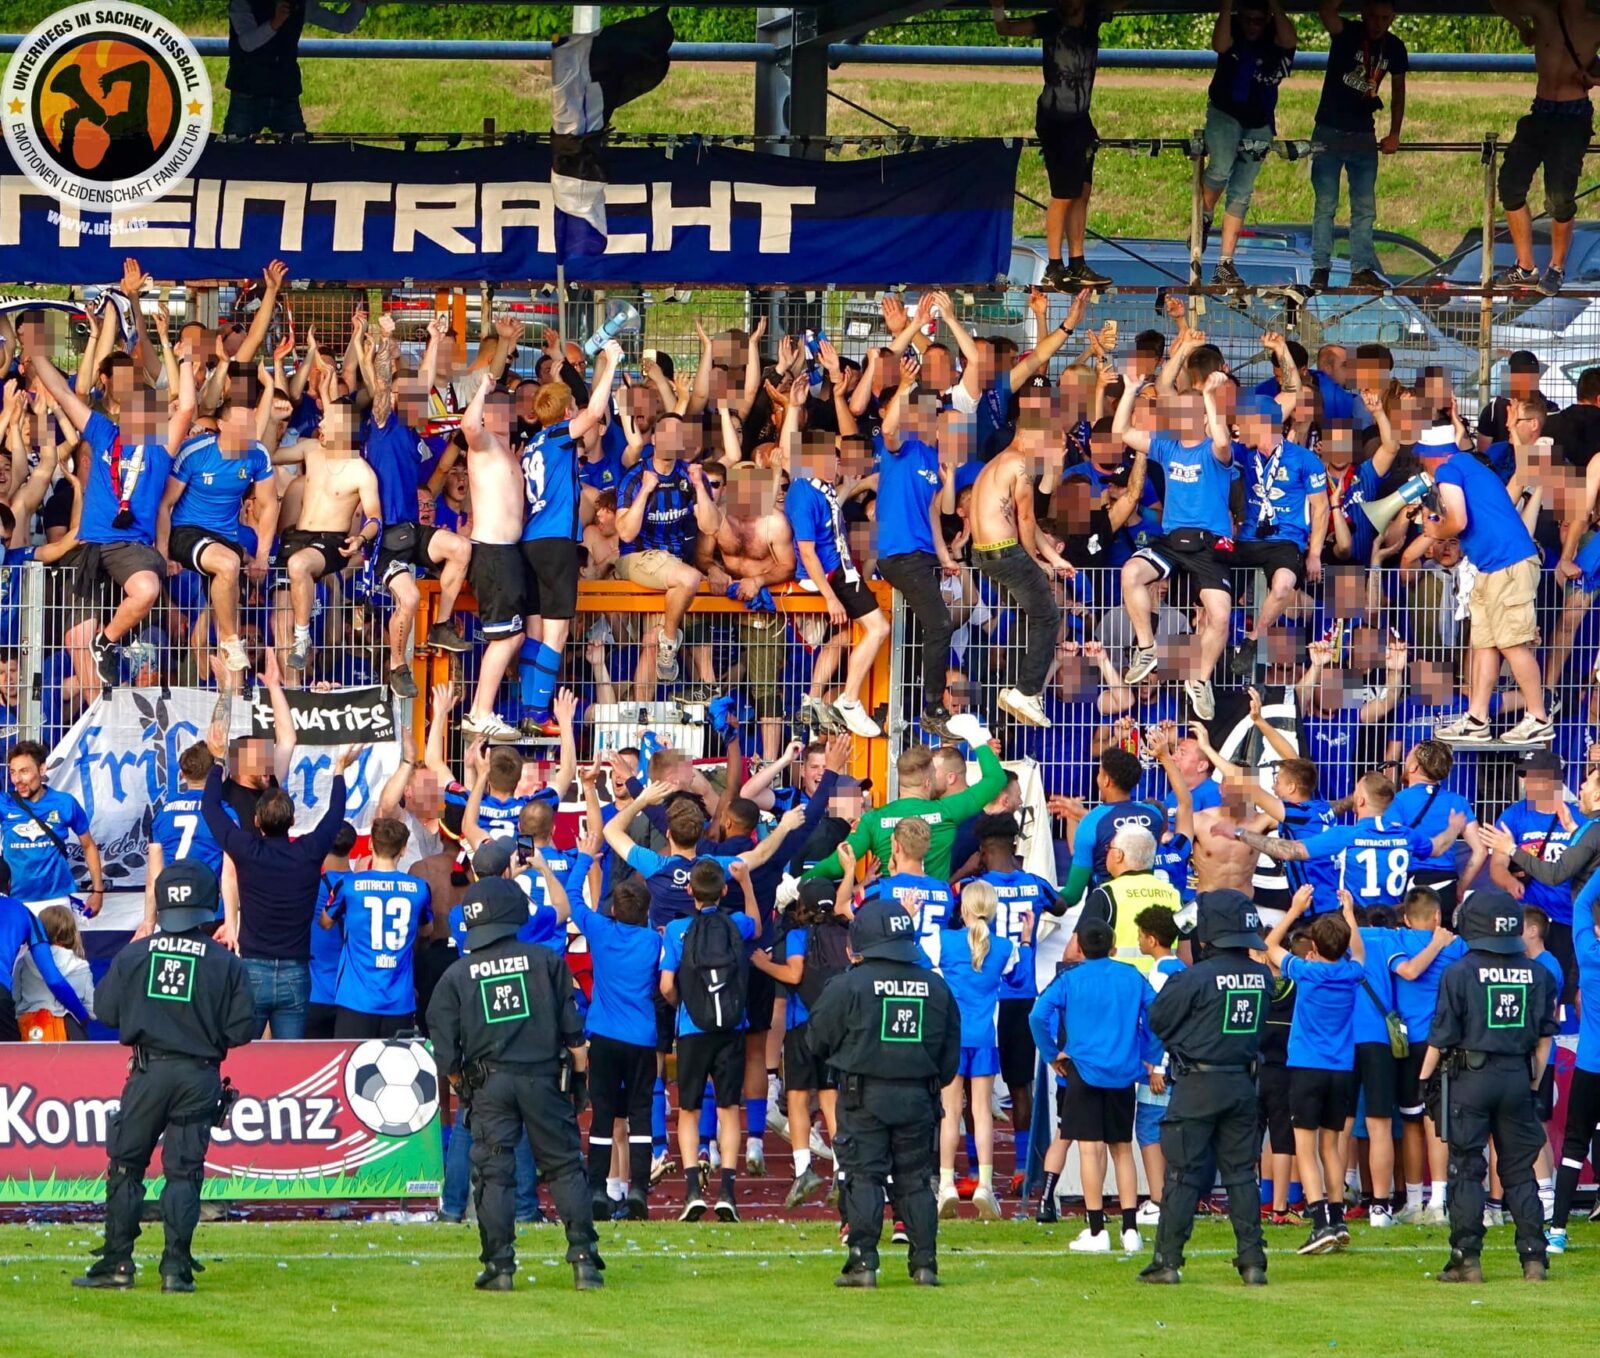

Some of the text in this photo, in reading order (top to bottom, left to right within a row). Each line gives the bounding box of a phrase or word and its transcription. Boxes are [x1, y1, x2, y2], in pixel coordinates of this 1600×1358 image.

[254, 704, 391, 731] FNATiCS
[173, 815, 198, 860] 7
[1354, 838, 1391, 847] EINTRACHT
[1355, 848, 1409, 897] 18
[354, 879, 418, 893] EINTRACHT TRIER
[893, 886, 929, 901] EINTCHT
[1126, 888, 1174, 899] SECURITY
[167, 885, 192, 903] RP
[463, 902, 484, 921] RP
[363, 896, 412, 951] 13
[889, 915, 911, 932] RP
[1245, 912, 1259, 928] RP
[1495, 917, 1518, 932] RP
[149, 937, 206, 957] POLIZEI
[164, 959, 182, 973] RP
[375, 953, 397, 968] KÖNIG
[469, 955, 529, 979] POLIZEI
[157, 971, 186, 986] 412
[1216, 974, 1266, 990] POLIZEI
[1479, 967, 1534, 983] POLIZEI
[495, 985, 512, 999] RP
[873, 981, 929, 996] POLIZEI
[493, 996, 520, 1011] 412
[1236, 999, 1249, 1011] RP
[1500, 994, 1515, 1006] RP
[897, 1009, 913, 1021] RP
[1231, 1011, 1253, 1023] 412
[891, 1021, 916, 1033] 412
[0, 1086, 337, 1144] Komenz
